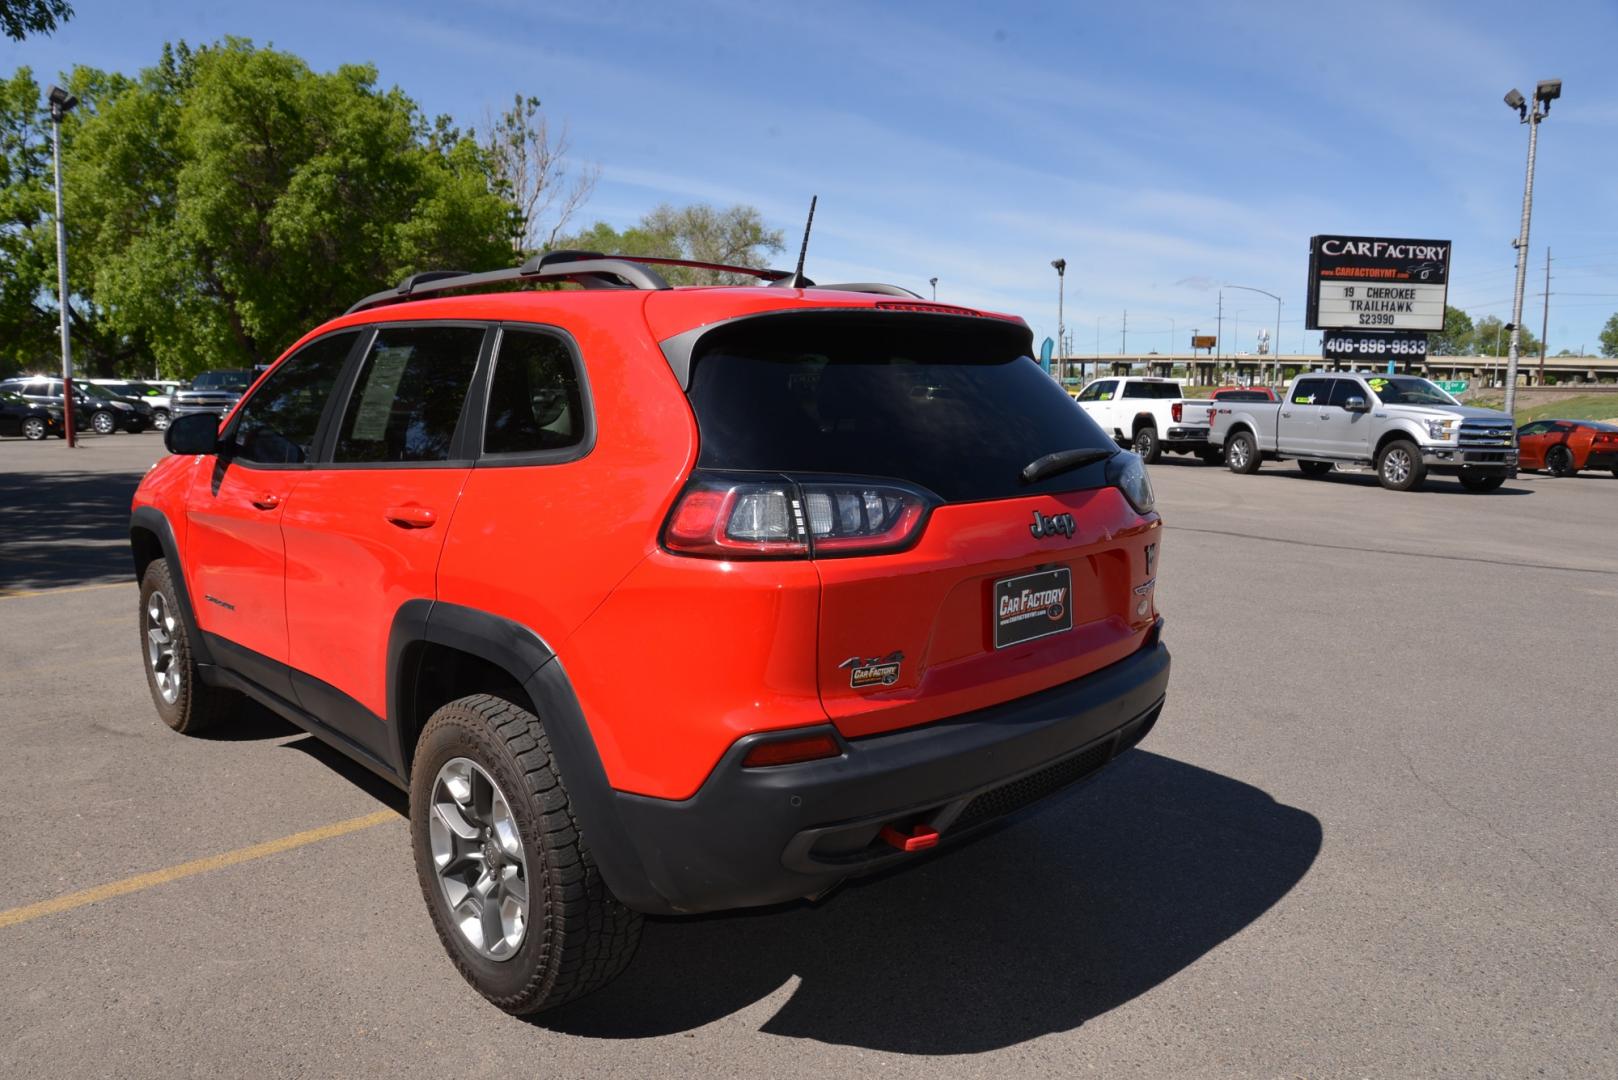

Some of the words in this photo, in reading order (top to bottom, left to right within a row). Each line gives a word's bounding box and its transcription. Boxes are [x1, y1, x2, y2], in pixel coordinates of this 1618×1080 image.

[1344, 287, 1354, 297] 19
[1366, 287, 1416, 299] CHEROKEE
[1350, 300, 1413, 312] TRAILHAWK
[1326, 338, 1426, 354] 406-896-9833
[1030, 511, 1075, 539] Jeep
[1000, 595, 1020, 616] CAR
[1020, 587, 1065, 610] FACTORY
